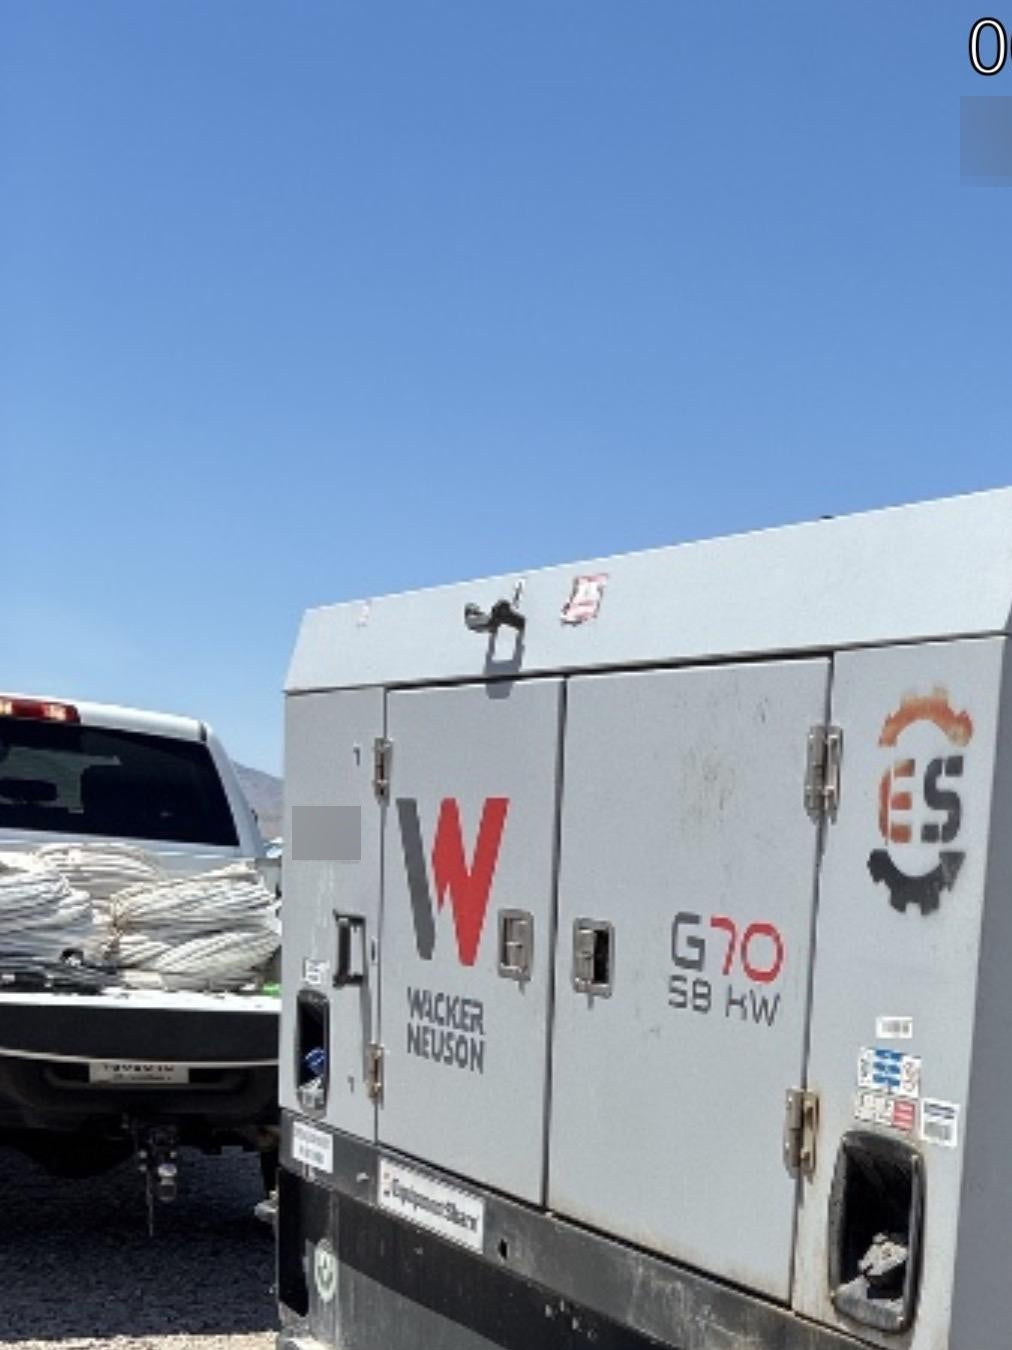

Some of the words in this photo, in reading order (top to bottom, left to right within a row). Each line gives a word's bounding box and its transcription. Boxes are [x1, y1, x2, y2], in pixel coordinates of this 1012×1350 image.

[879, 755, 963, 843] ES
[671, 911, 783, 983] G70
[407, 987, 485, 1035] WACKER
[668, 974, 711, 1014] 58
[407, 1023, 484, 1074] NEUSON
